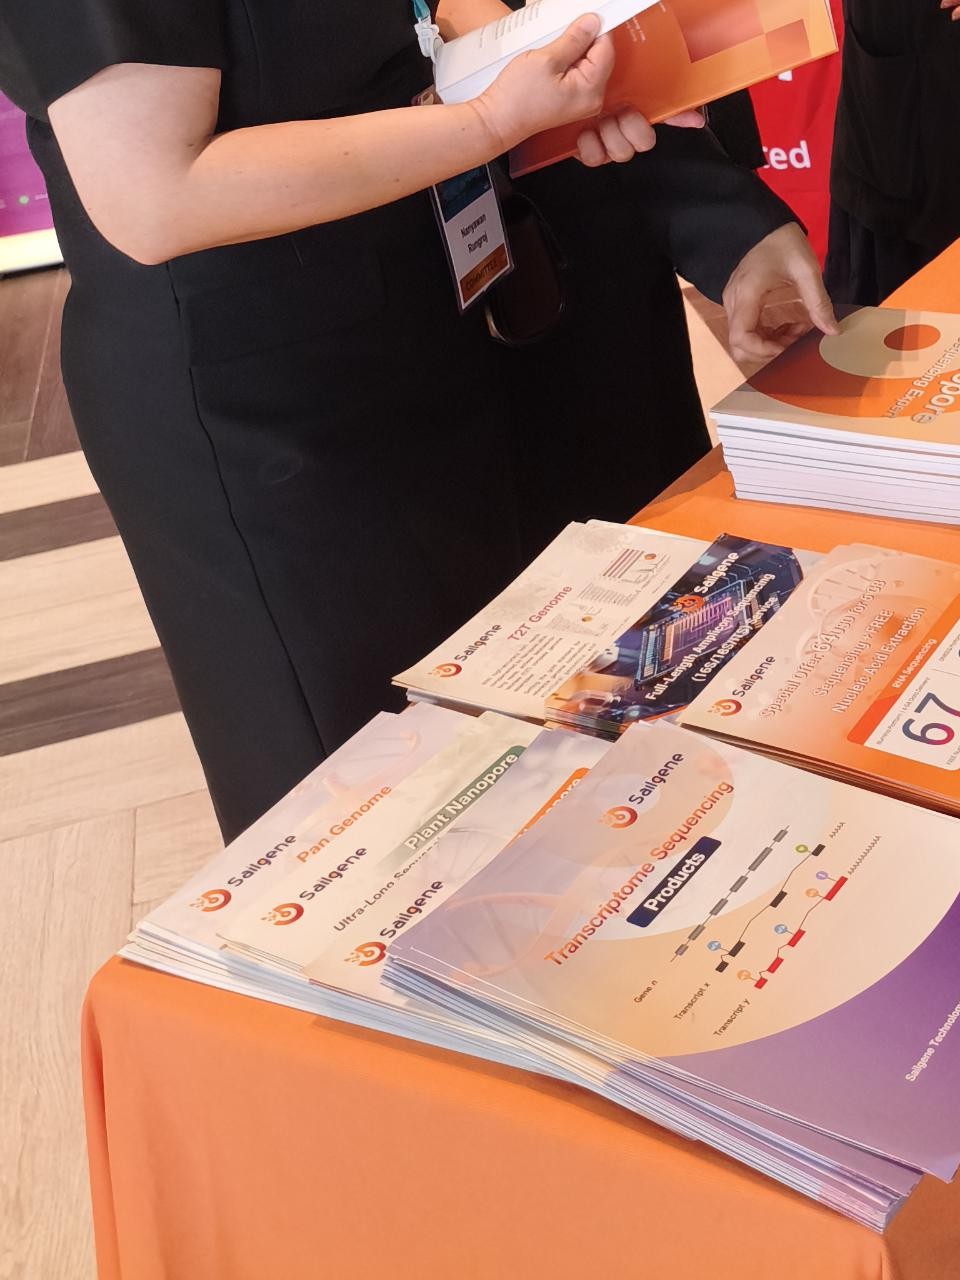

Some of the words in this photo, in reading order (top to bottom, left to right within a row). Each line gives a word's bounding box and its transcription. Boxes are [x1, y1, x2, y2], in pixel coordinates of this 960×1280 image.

[694, 551, 740, 595] Sailgene
[507, 623, 532, 642] T2T
[530, 584, 573, 624] Genome
[645, 651, 699, 701] Full-Length
[693, 616, 734, 655] Amplicon
[727, 572, 776, 618] Sequencing
[750, 595, 778, 625] Service
[454, 622, 503, 663] Sailgene
[813, 639, 870, 697] Sequencing
[866, 609, 894, 634] FREE
[832, 675, 872, 714] Nucleic
[864, 650, 888, 677] Acid
[882, 607, 927, 654] Extraction
[892, 672, 907, 689] RNA
[904, 638, 938, 680] Sequencing
[733, 655, 777, 698] Sailgene
[759, 678, 800, 718] Special
[403, 811, 451, 851] Plant
[446, 752, 519, 816] Nanopore
[628, 751, 684, 806] Sailgene
[296, 837, 331, 865] Pan
[328, 784, 393, 838] Genome
[226, 833, 298, 889] Sailgene
[299, 846, 368, 902] Sailgene
[543, 860, 656, 968] Transcriptome
[650, 781, 735, 861] Sequencing
[643, 851, 706, 913] Products
[379, 880, 445, 939] Sailgene
[633, 985, 654, 1005] Gene
[673, 988, 706, 1022] Transcript
[713, 1005, 746, 1039] Transcript
[905, 1047, 936, 1082] Sailgene
